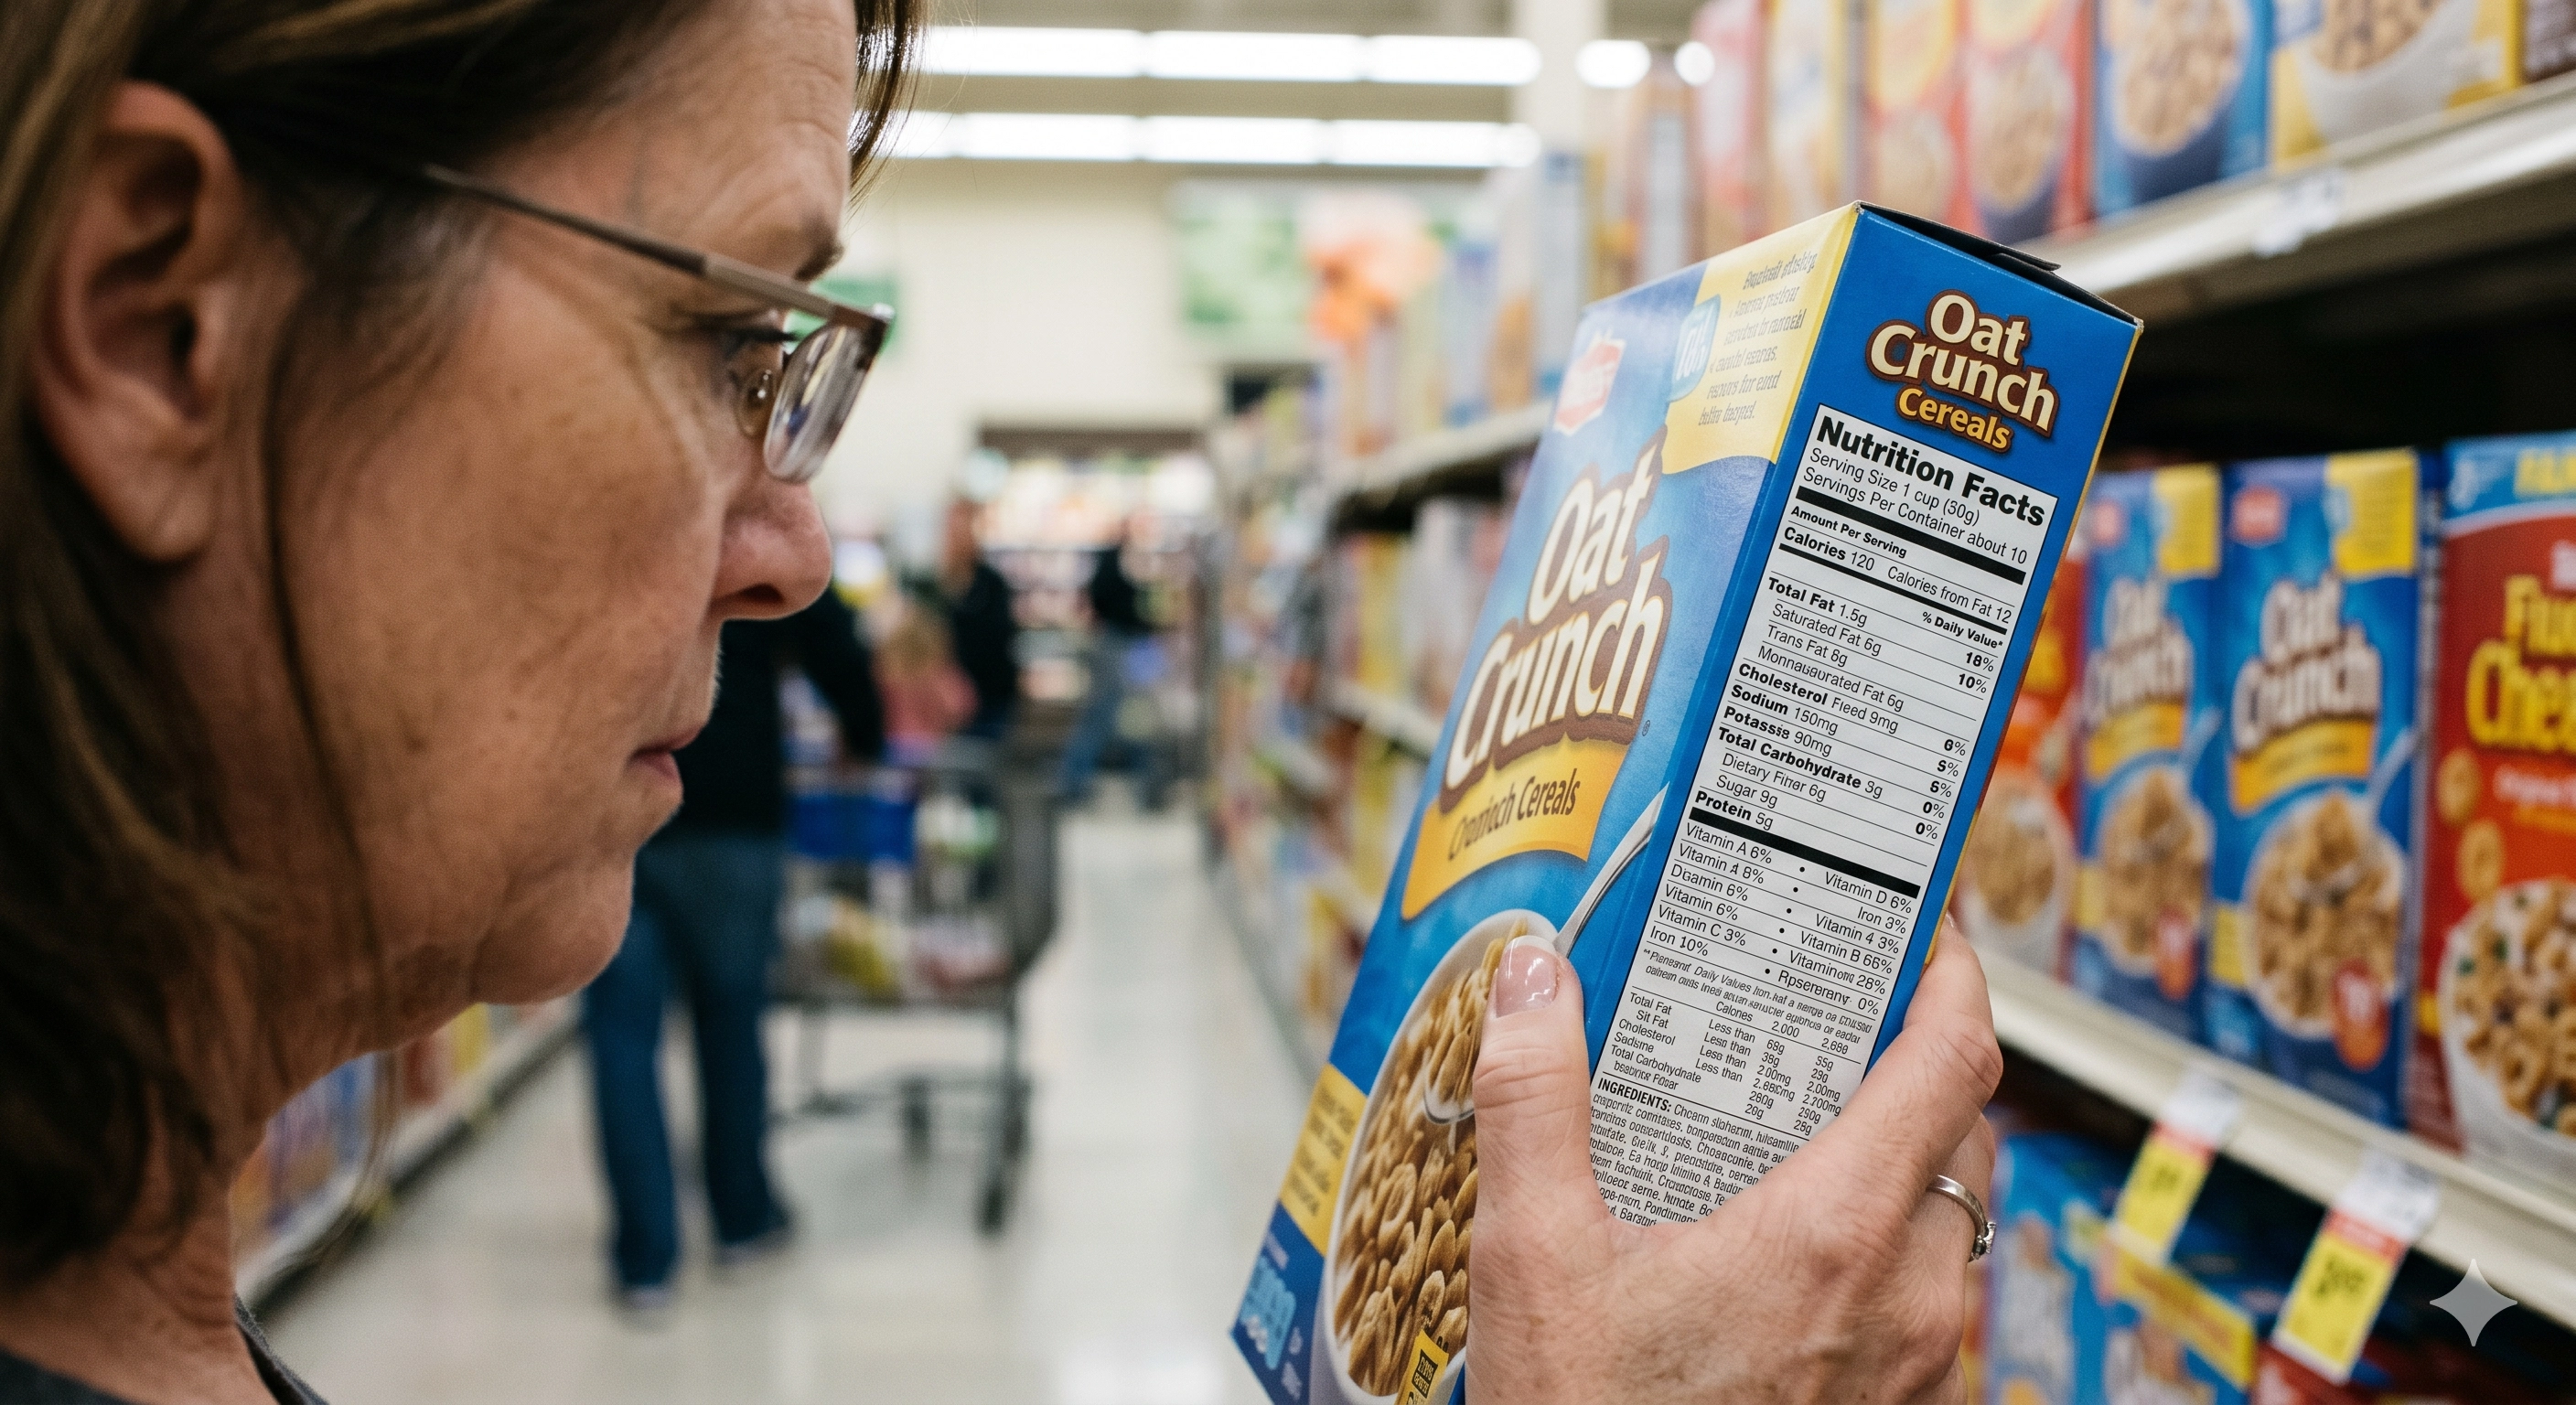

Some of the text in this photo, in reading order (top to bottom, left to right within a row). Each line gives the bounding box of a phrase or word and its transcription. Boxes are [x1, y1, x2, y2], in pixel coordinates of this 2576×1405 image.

[1930, 295, 2026, 366] Oat
[1871, 324, 2055, 432] Crunch
[1899, 388, 2011, 449] Cereals
[1810, 447, 1980, 527] Serving Size 1 cup (30g)
[1817, 415, 2045, 526] Nutrition Facts
[1529, 444, 1658, 626] Oat
[1790, 505, 1907, 559] Amount Per Serving
[1803, 467, 2027, 564] Servings Per Container about 10
[1784, 526, 1875, 571] Calories 120
[1768, 576, 1868, 628] Total Fat 1.5g
[1888, 565, 2012, 624] Calories from Fat 12
[1768, 624, 1803, 649] Trans
[1806, 638, 1829, 659] Fat
[1773, 603, 1882, 657] Saturated Fat 6g
[1922, 611, 1932, 624] %
[1934, 616, 1965, 637] Daily
[1446, 551, 1665, 789] Crunch
[1966, 651, 1994, 672] 18%
[1731, 684, 1788, 715] Sodium
[1739, 663, 1829, 705] Cholesterol
[1869, 711, 1899, 735] 9mg
[1862, 683, 1885, 703] Fat
[1887, 693, 1905, 713] 6g
[1959, 673, 1987, 693] 10%
[1719, 726, 1757, 751] Total
[1760, 743, 1862, 788] Carbohydrate
[1794, 731, 1832, 757] 90mg
[1517, 768, 1582, 821] Cereals
[1716, 775, 1778, 810] Sugar 9g
[1723, 753, 1771, 782] Dietary
[1809, 784, 1827, 803] 6g
[1695, 790, 1752, 820] Protein
[1923, 801, 1945, 819] 0%
[1687, 822, 1772, 864] Vitamin A 6%
[1916, 821, 1937, 840] 0%
[1726, 884, 1748, 902] 6%
[1743, 866, 1764, 885] 8%
[1826, 871, 1912, 914] Vitamin D 6%
[1666, 883, 1738, 921] Vitamin 6%
[1857, 906, 1882, 926] Iron
[1650, 925, 1708, 957] Iron 10%
[1659, 904, 1746, 946] Vitamin C 3%
[1817, 913, 1899, 954] Vitamin 4 3%
[1801, 930, 1848, 959] Vitamin
[1850, 949, 1861, 962] B
[1856, 974, 1885, 995] 28%
[1630, 992, 1655, 1009] Total
[1656, 1001, 1672, 1015] Fat
[1709, 1018, 1733, 1035] Less
[1734, 1027, 1755, 1043] than
[1858, 997, 1879, 1015] 0%
[1612, 1044, 1635, 1061] Total
[1619, 1018, 1676, 1046] Cholesterol
[1725, 1054, 1746, 1069] than
[1652, 1014, 1669, 1029] Fat
[1730, 1040, 1751, 1056] than
[1695, 1057, 1719, 1075] Less
[1722, 1067, 1743, 1082] than
[1597, 1078, 1672, 1112] INGREDIENTS:
